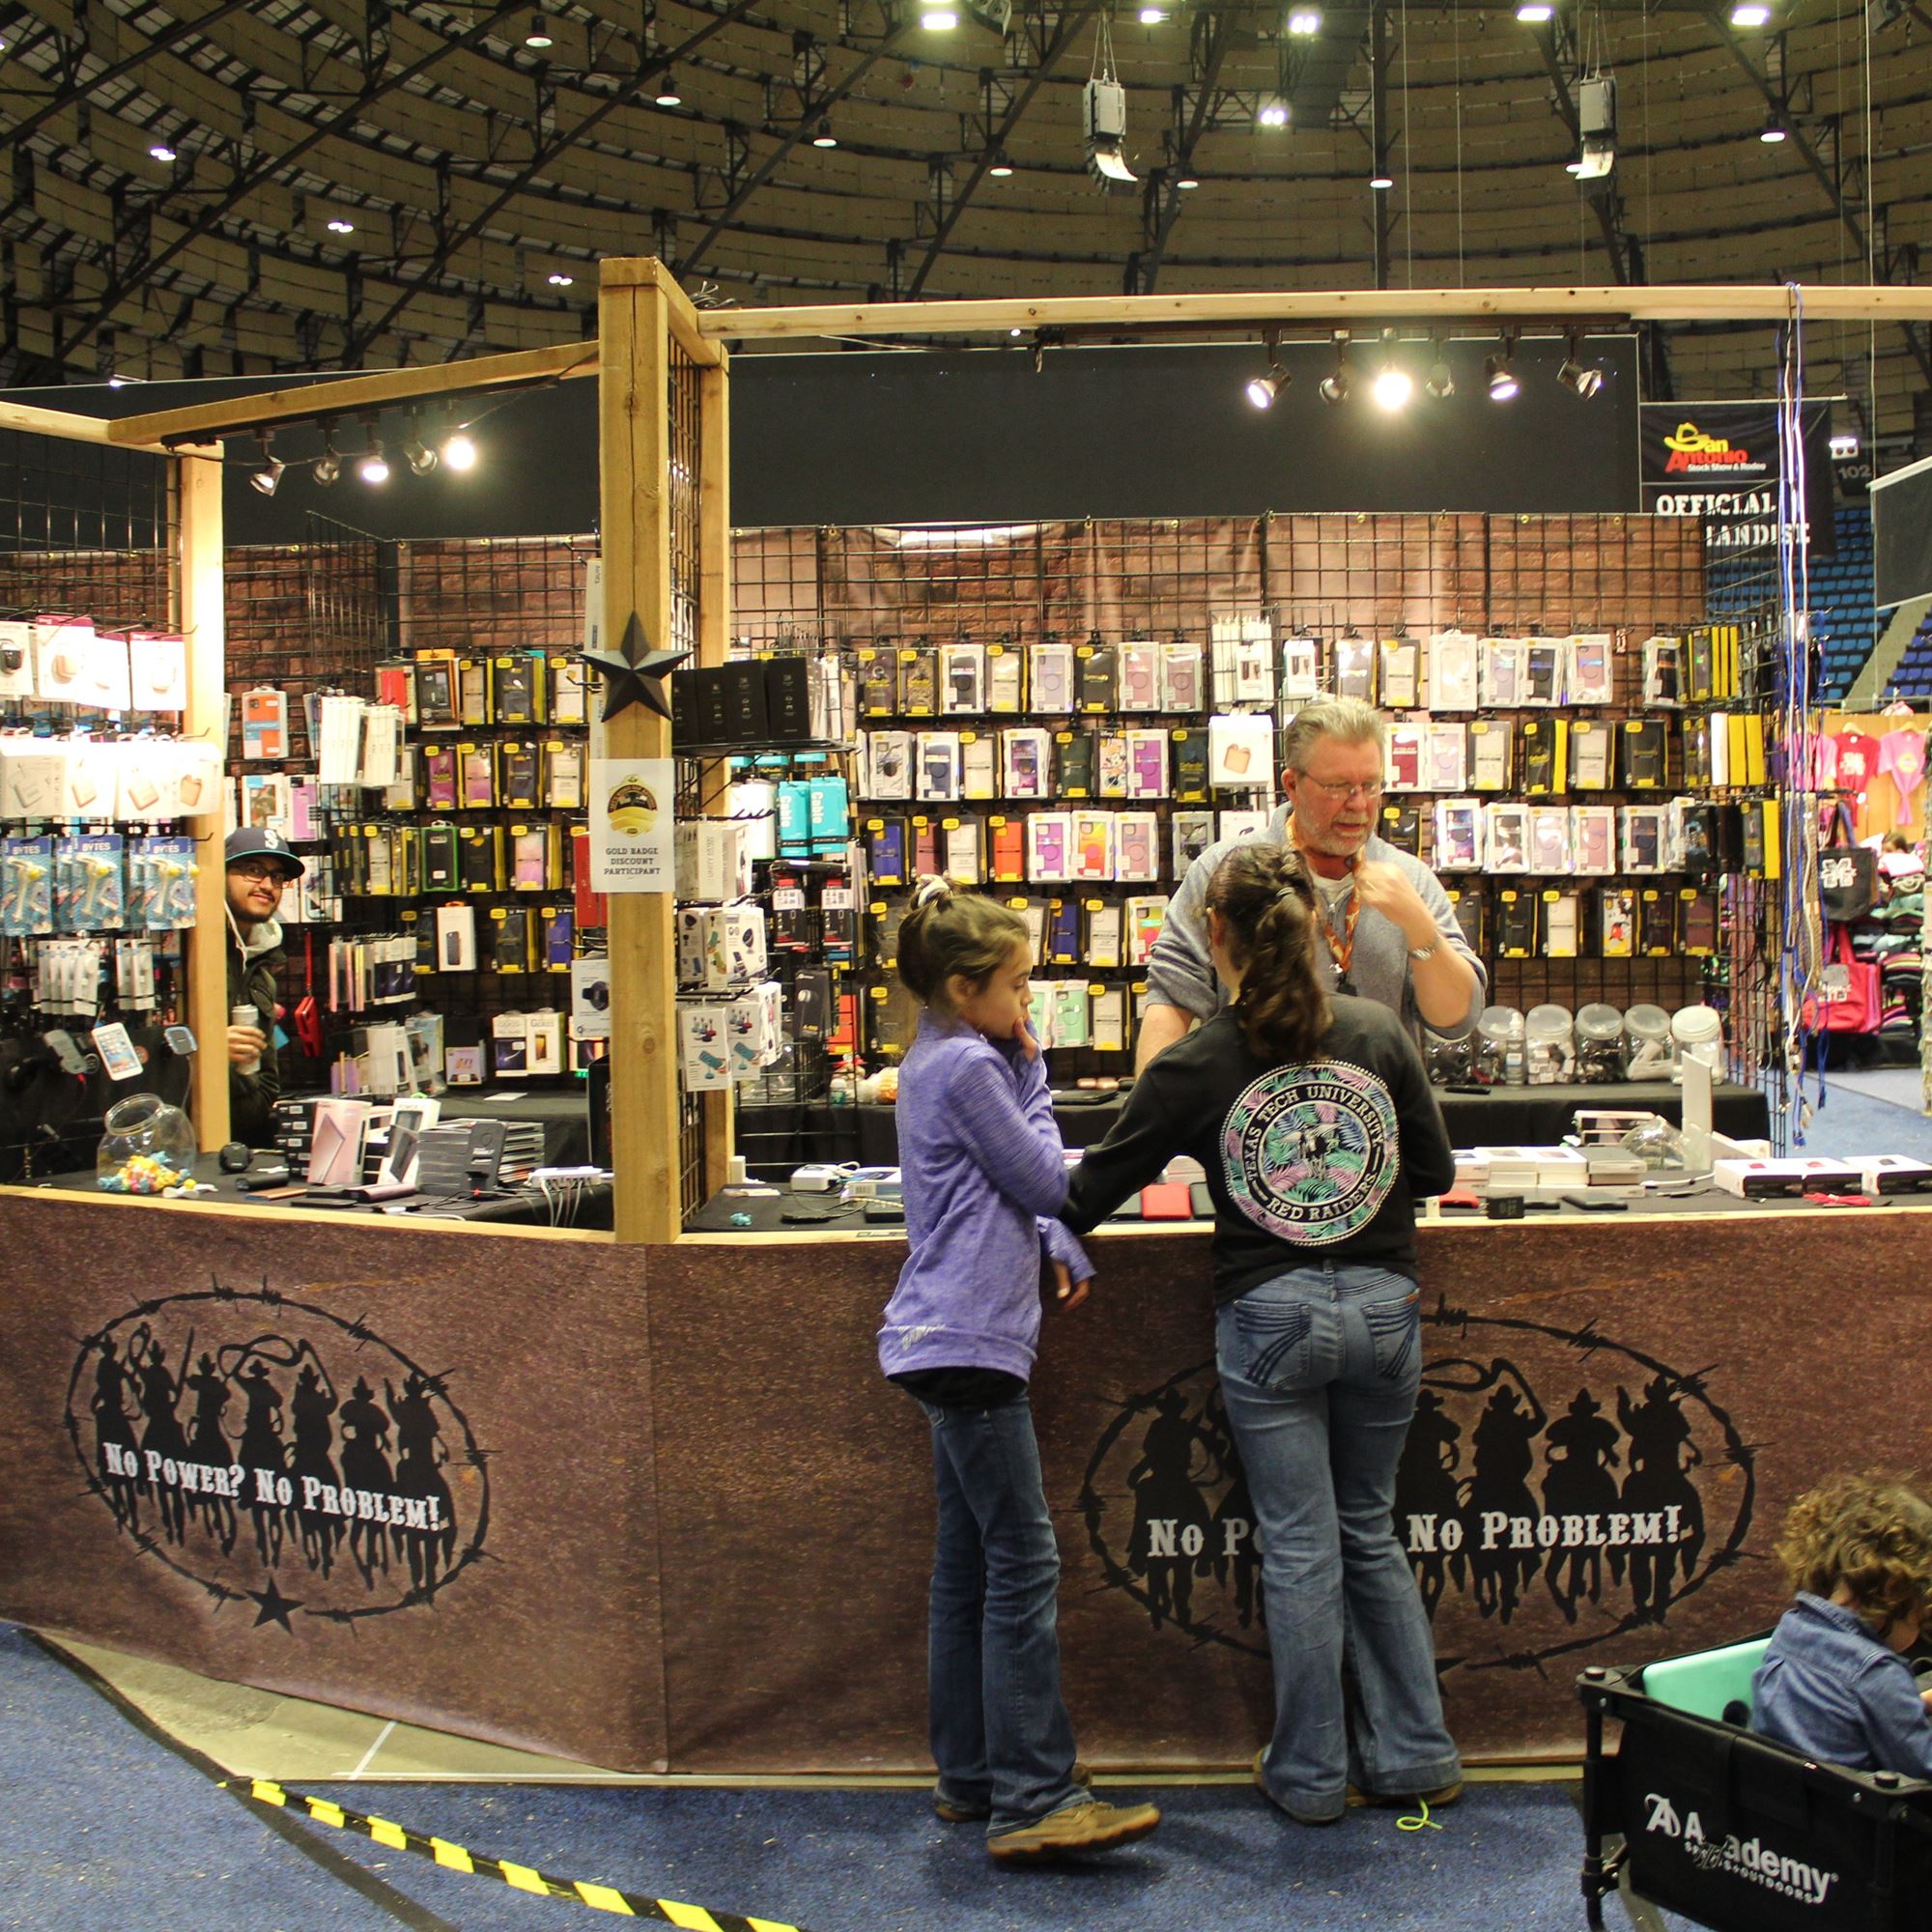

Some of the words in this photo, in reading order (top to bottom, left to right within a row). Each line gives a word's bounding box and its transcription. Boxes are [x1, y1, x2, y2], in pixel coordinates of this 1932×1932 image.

[1838, 465, 1871, 479] 102
[1657, 494, 1776, 516] OFFICIAL
[82, 841, 111, 852] BYTES
[1244, 1127, 1263, 1181] TEXAS
[1259, 1091, 1299, 1122] TECH
[1307, 1086, 1384, 1148] UNIVERSITY
[1266, 1198, 1304, 1220] RED
[1309, 1173, 1378, 1220] RAIDERS
[1684, 1811, 1831, 1904] Aademy
